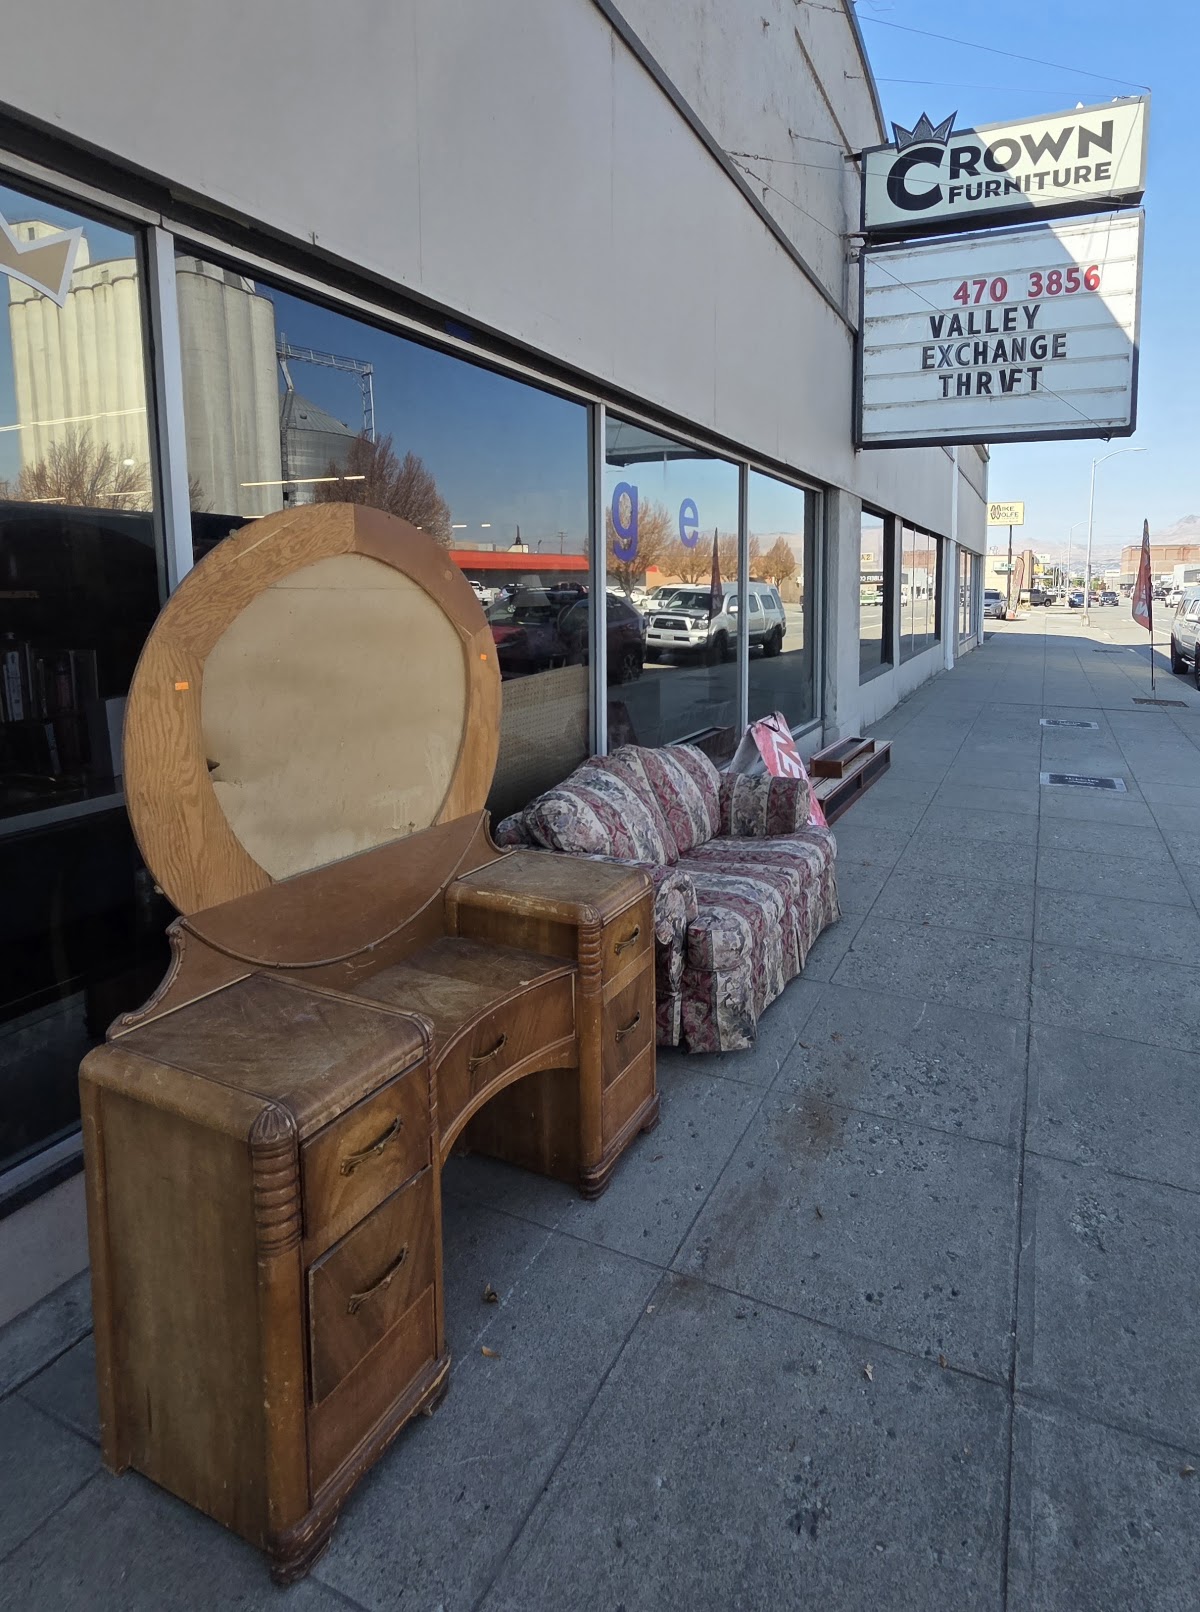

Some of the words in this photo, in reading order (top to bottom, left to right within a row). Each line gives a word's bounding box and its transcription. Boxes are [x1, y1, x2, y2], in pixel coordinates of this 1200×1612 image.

[887, 120, 1114, 211] CROWN
[949, 162, 1112, 204] FURNITURE
[953, 276, 1008, 305] 470
[1027, 264, 1101, 298] 3856
[929, 304, 1041, 339] VALLEY
[922, 333, 1067, 370] EXCHANGE
